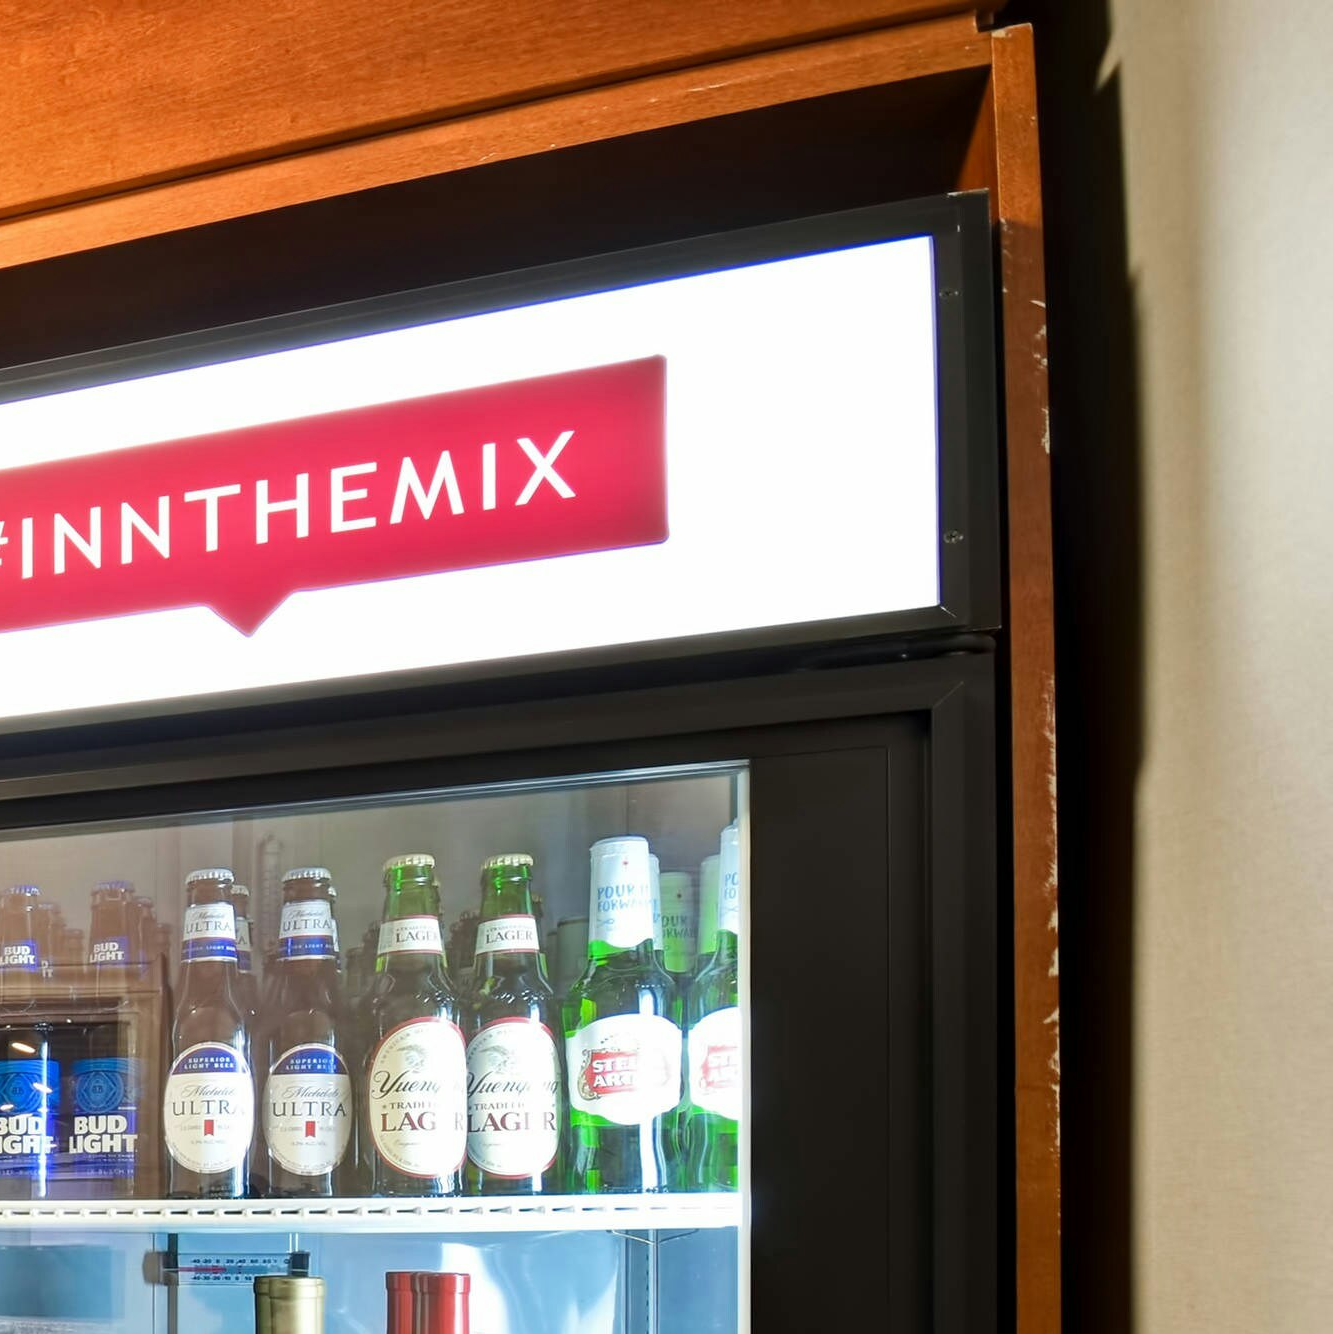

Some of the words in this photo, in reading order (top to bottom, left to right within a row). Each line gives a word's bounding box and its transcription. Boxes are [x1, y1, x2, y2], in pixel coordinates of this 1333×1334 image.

[185, 920, 233, 934] ULTRA
[284, 918, 332, 932] ULTRA
[486, 929, 534, 944] LAGER
[4, 945, 31, 956] BUD
[93, 942, 119, 953] BUD
[0, 954, 35, 965] LIGHT
[90, 951, 125, 963] LIGHT
[184, 1063, 211, 1071] LIGHT
[172, 1100, 245, 1116] ULTRA
[272, 1101, 347, 1118] ULTRA
[74, 1115, 128, 1134] BUD
[69, 1133, 138, 1154] LIGHT
